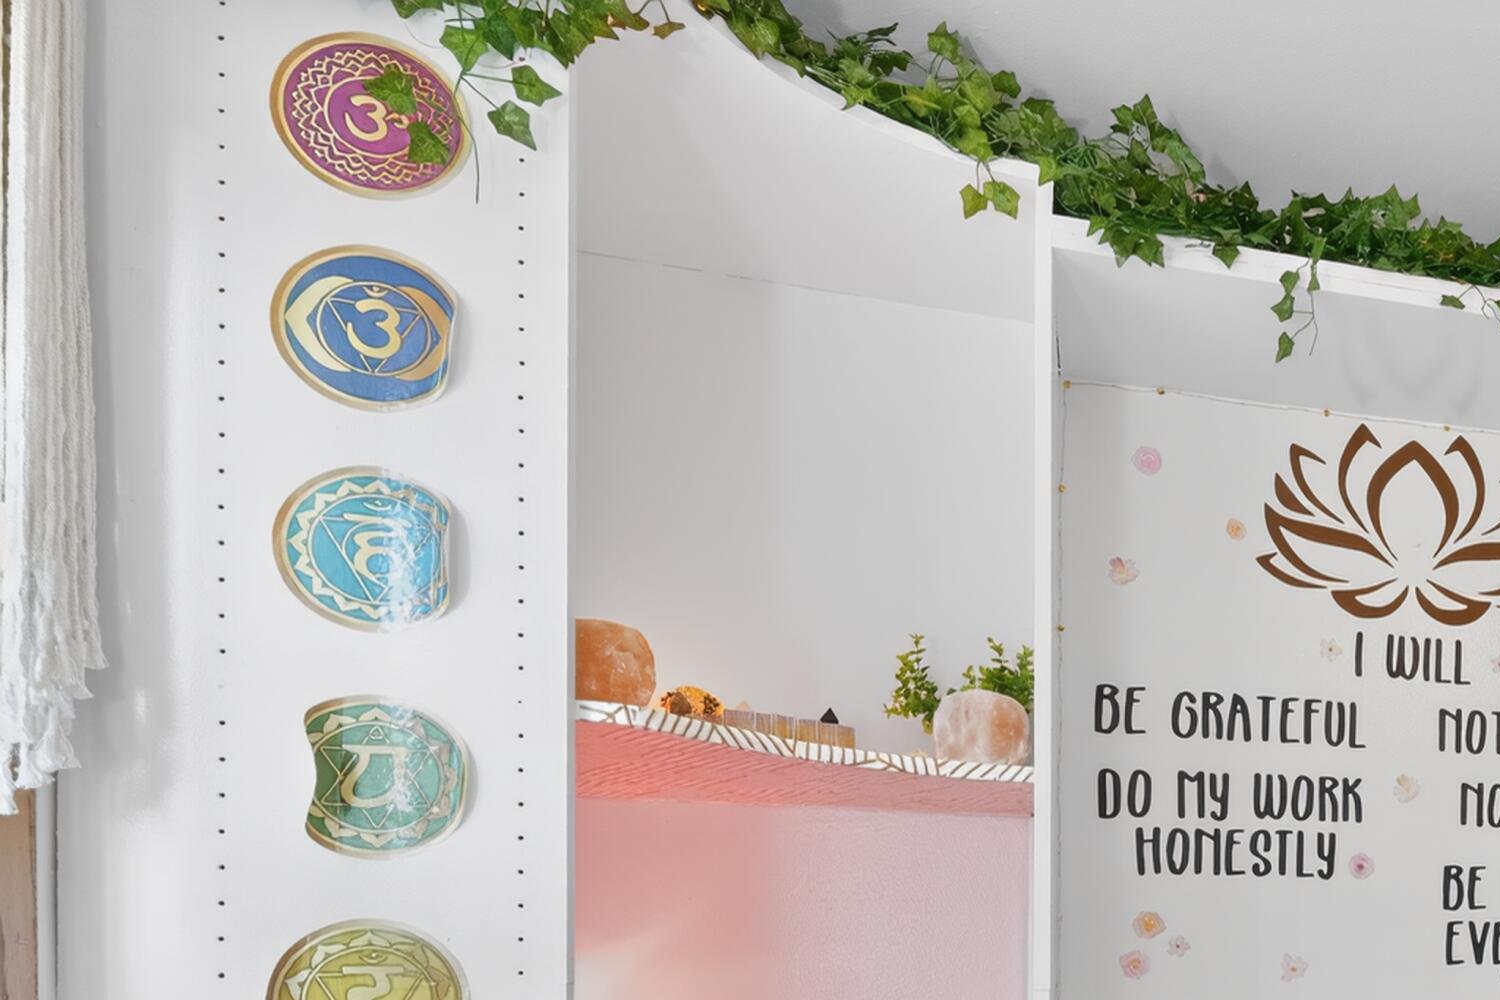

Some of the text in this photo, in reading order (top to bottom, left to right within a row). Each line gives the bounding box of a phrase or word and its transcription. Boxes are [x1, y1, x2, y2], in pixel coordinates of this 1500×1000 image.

[1354, 631, 1471, 685] I WILL
[1094, 683, 1366, 749] BE GRATEFUL
[1097, 767, 1363, 824] DO MY WORK
[1135, 826, 1337, 881] HONESTLY
[1442, 864, 1487, 911] BE
